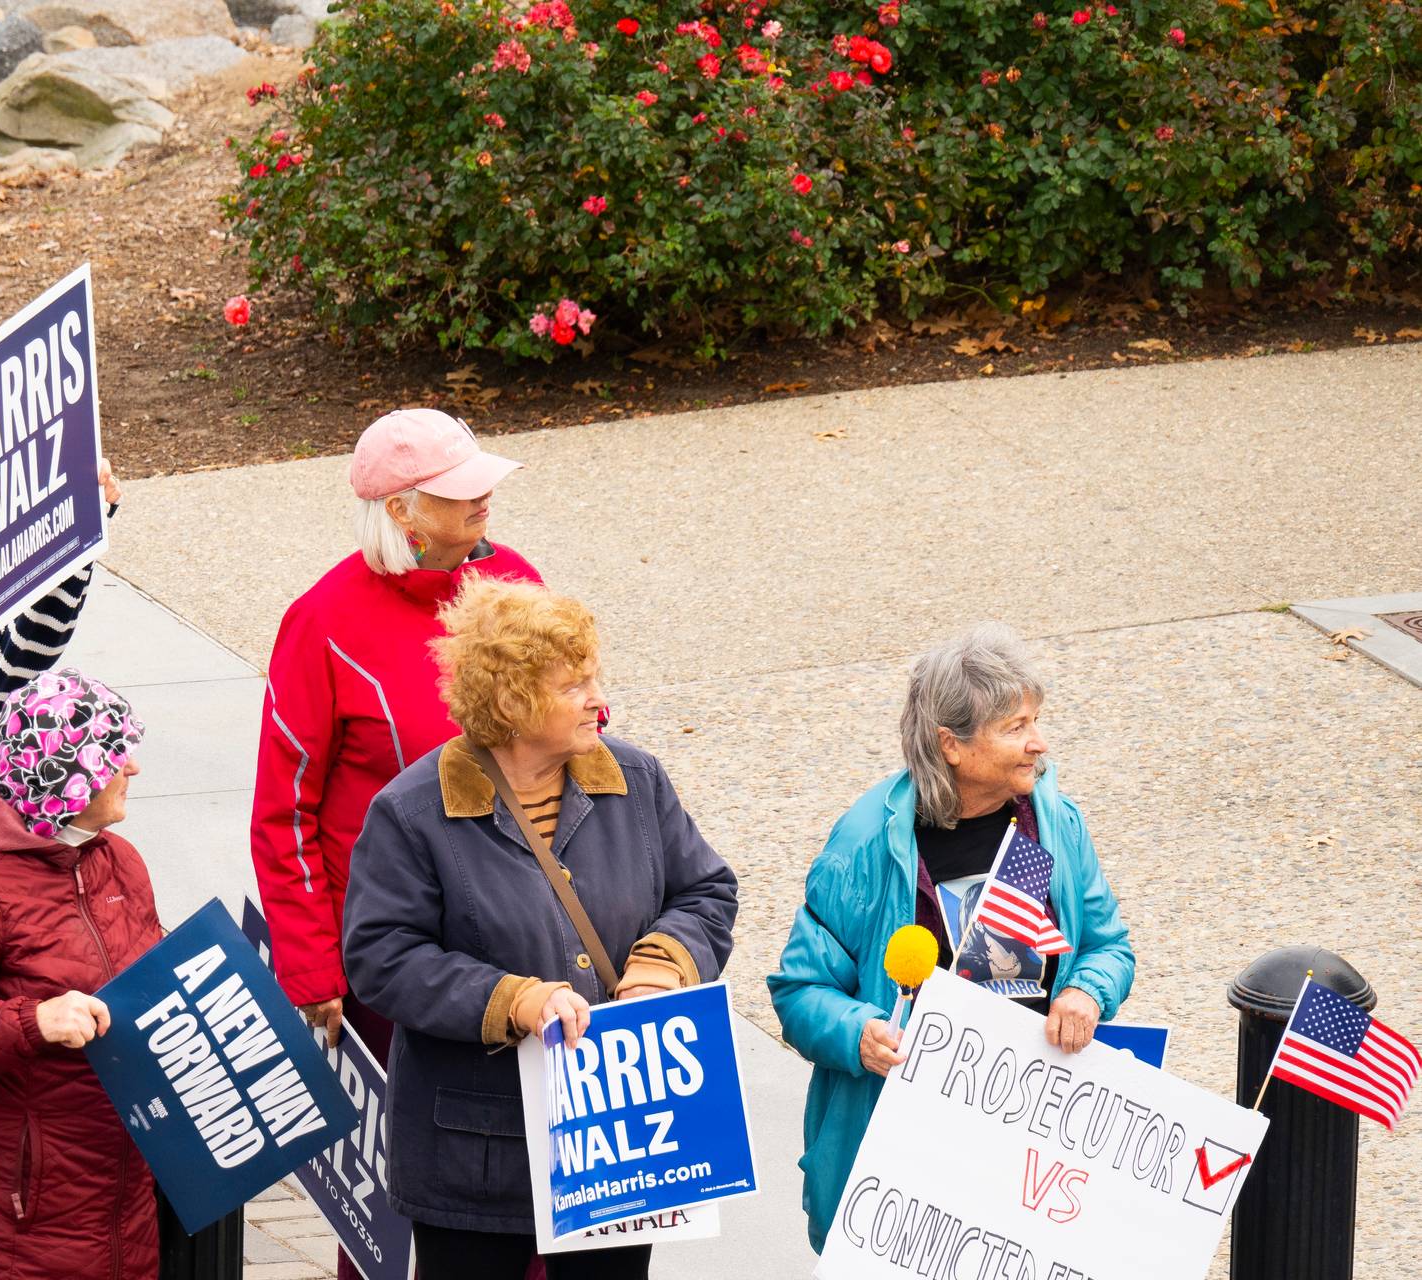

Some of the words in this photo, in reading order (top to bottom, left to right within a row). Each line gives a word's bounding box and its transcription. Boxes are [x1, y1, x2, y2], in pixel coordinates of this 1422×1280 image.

[173, 944, 227, 994] A
[978, 978, 1043, 996] WARD
[196, 972, 285, 1074] NEW
[135, 990, 265, 1169] FORWARD
[246, 1057, 327, 1148] WAY
[900, 1012, 1186, 1194] PROSECUTOR
[558, 1110, 680, 1177] WALZ
[554, 1160, 712, 1213] KamalaHarris.com
[1022, 1148, 1089, 1224] VS
[341, 1196, 383, 1265] 30330
